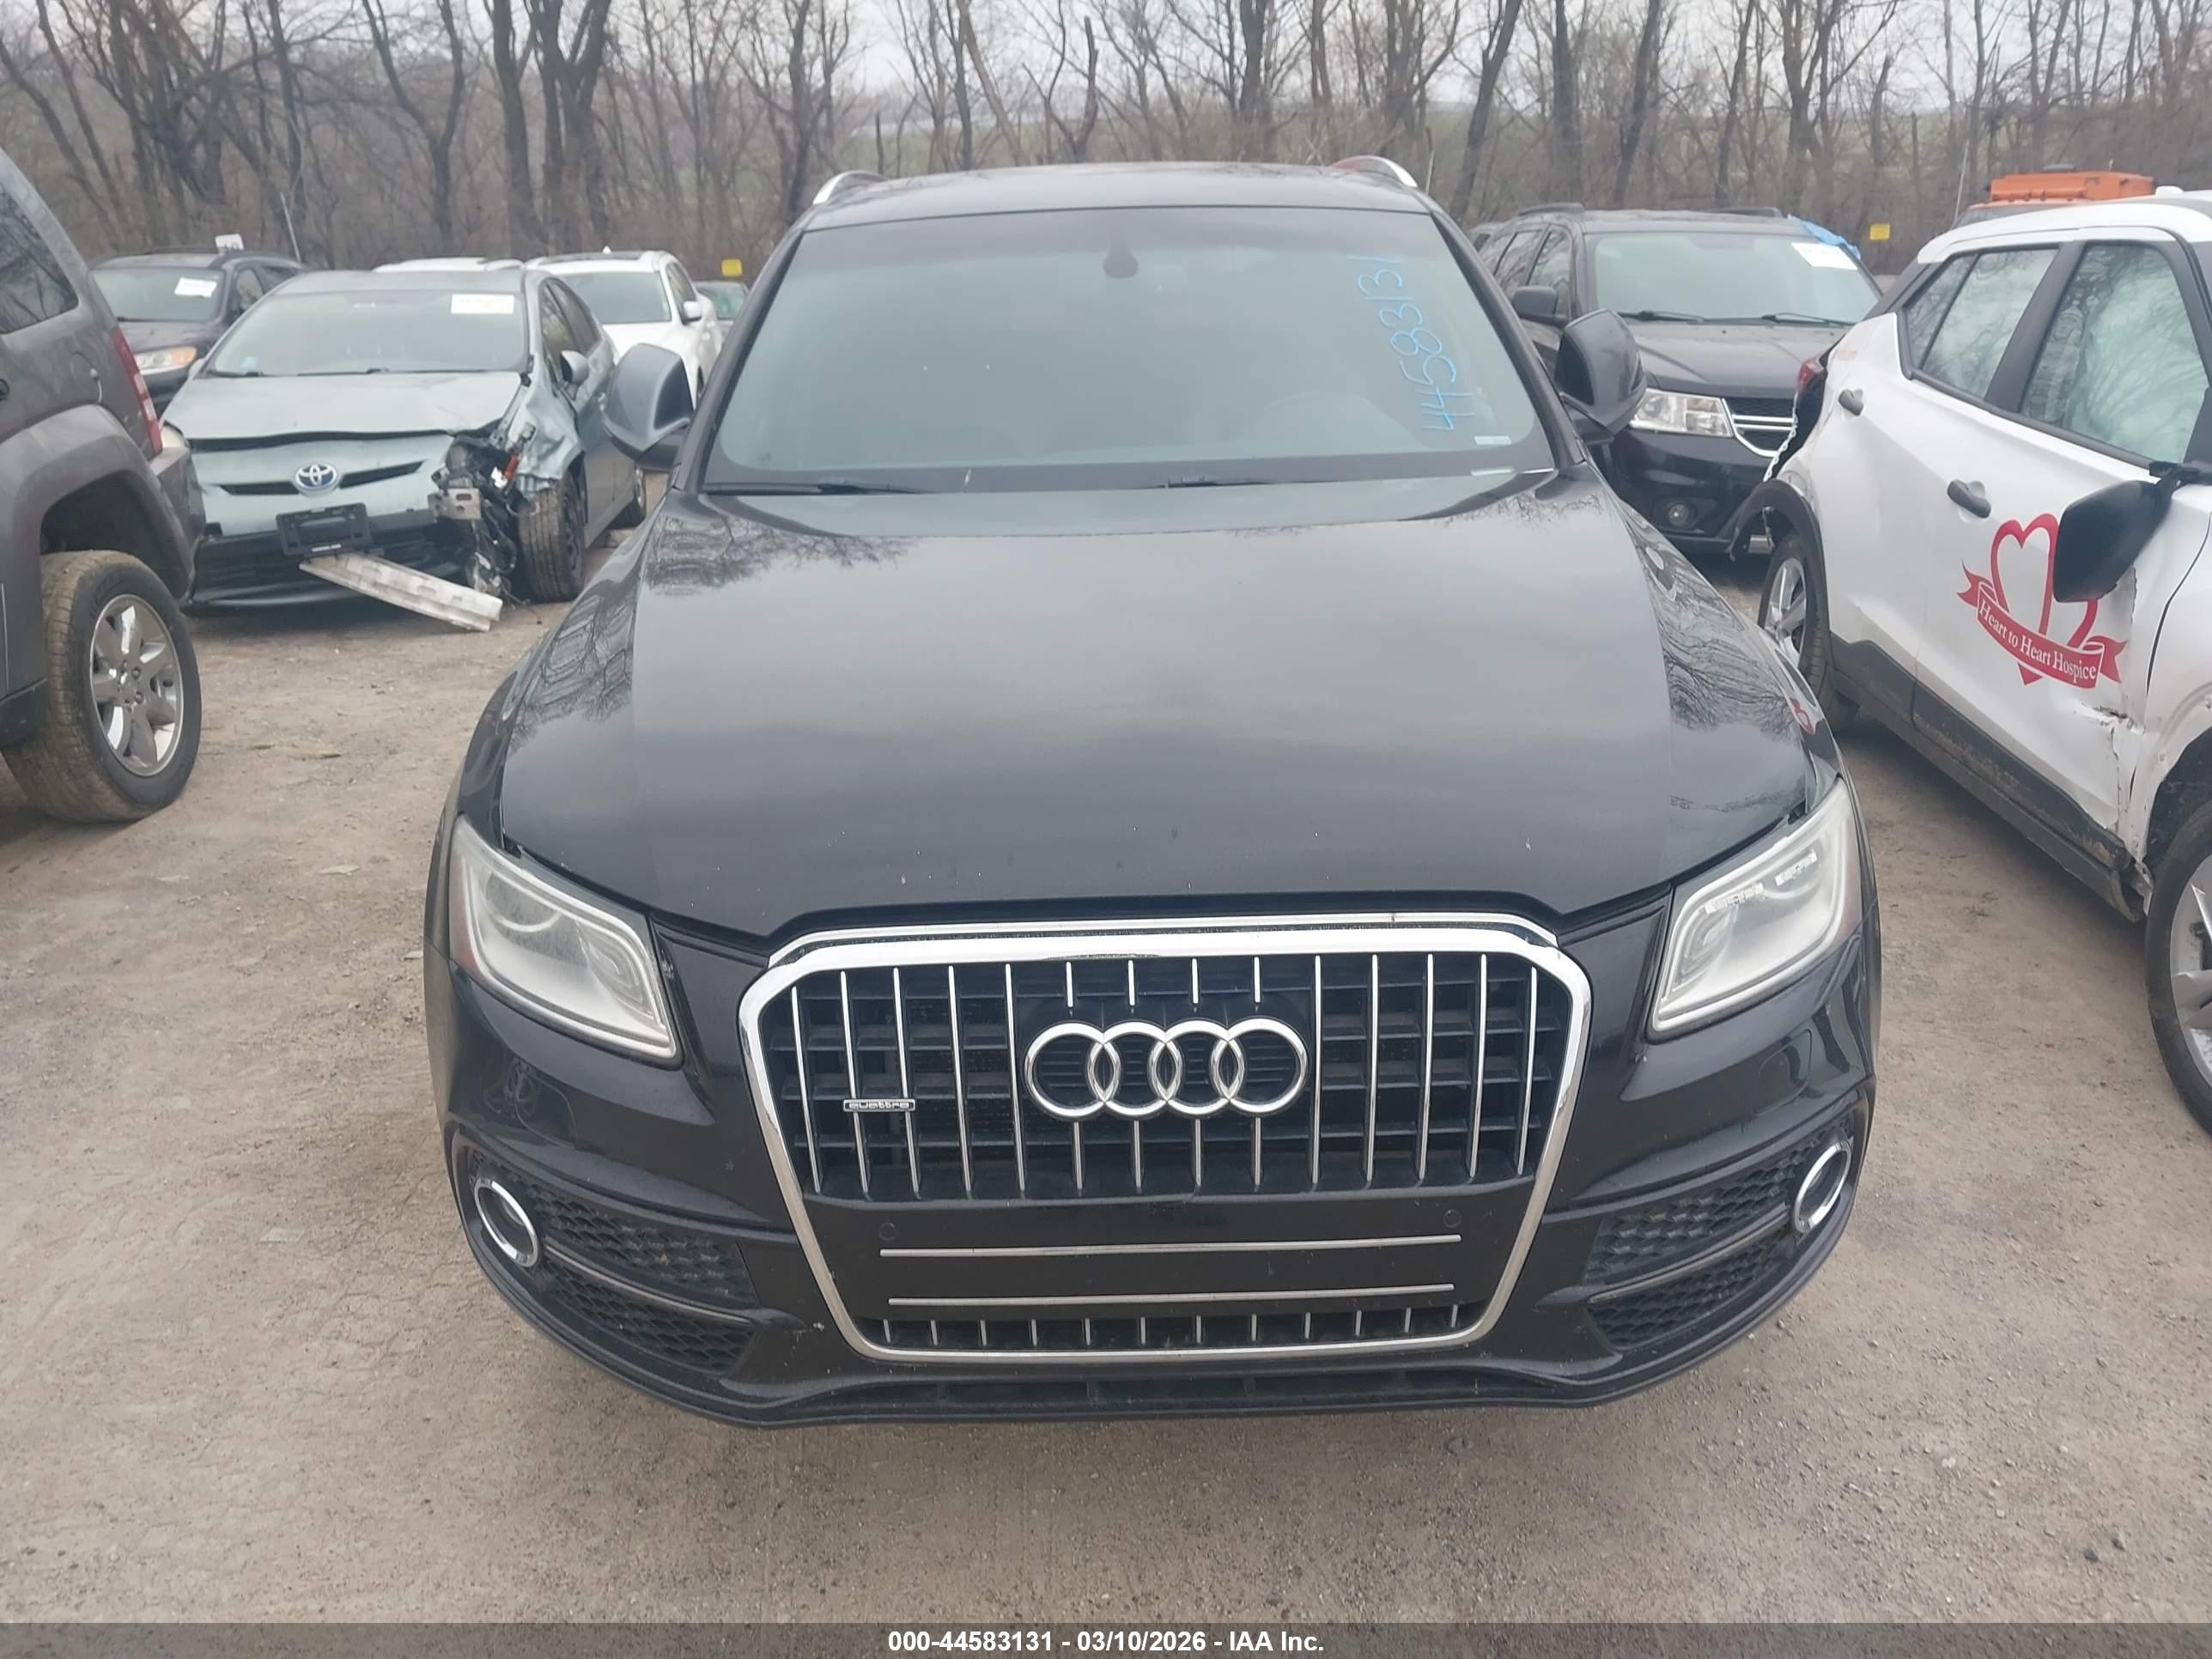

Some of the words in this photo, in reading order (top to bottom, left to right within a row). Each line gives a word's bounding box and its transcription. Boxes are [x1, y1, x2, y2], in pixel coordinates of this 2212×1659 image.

[1348, 256, 1475, 432] 44583131
[1979, 600, 2008, 639] Heart
[2008, 631, 2018, 647] to
[2020, 635, 2051, 665] Heart
[2052, 652, 2097, 684] Hospice
[848, 1101, 909, 1110] quattro
